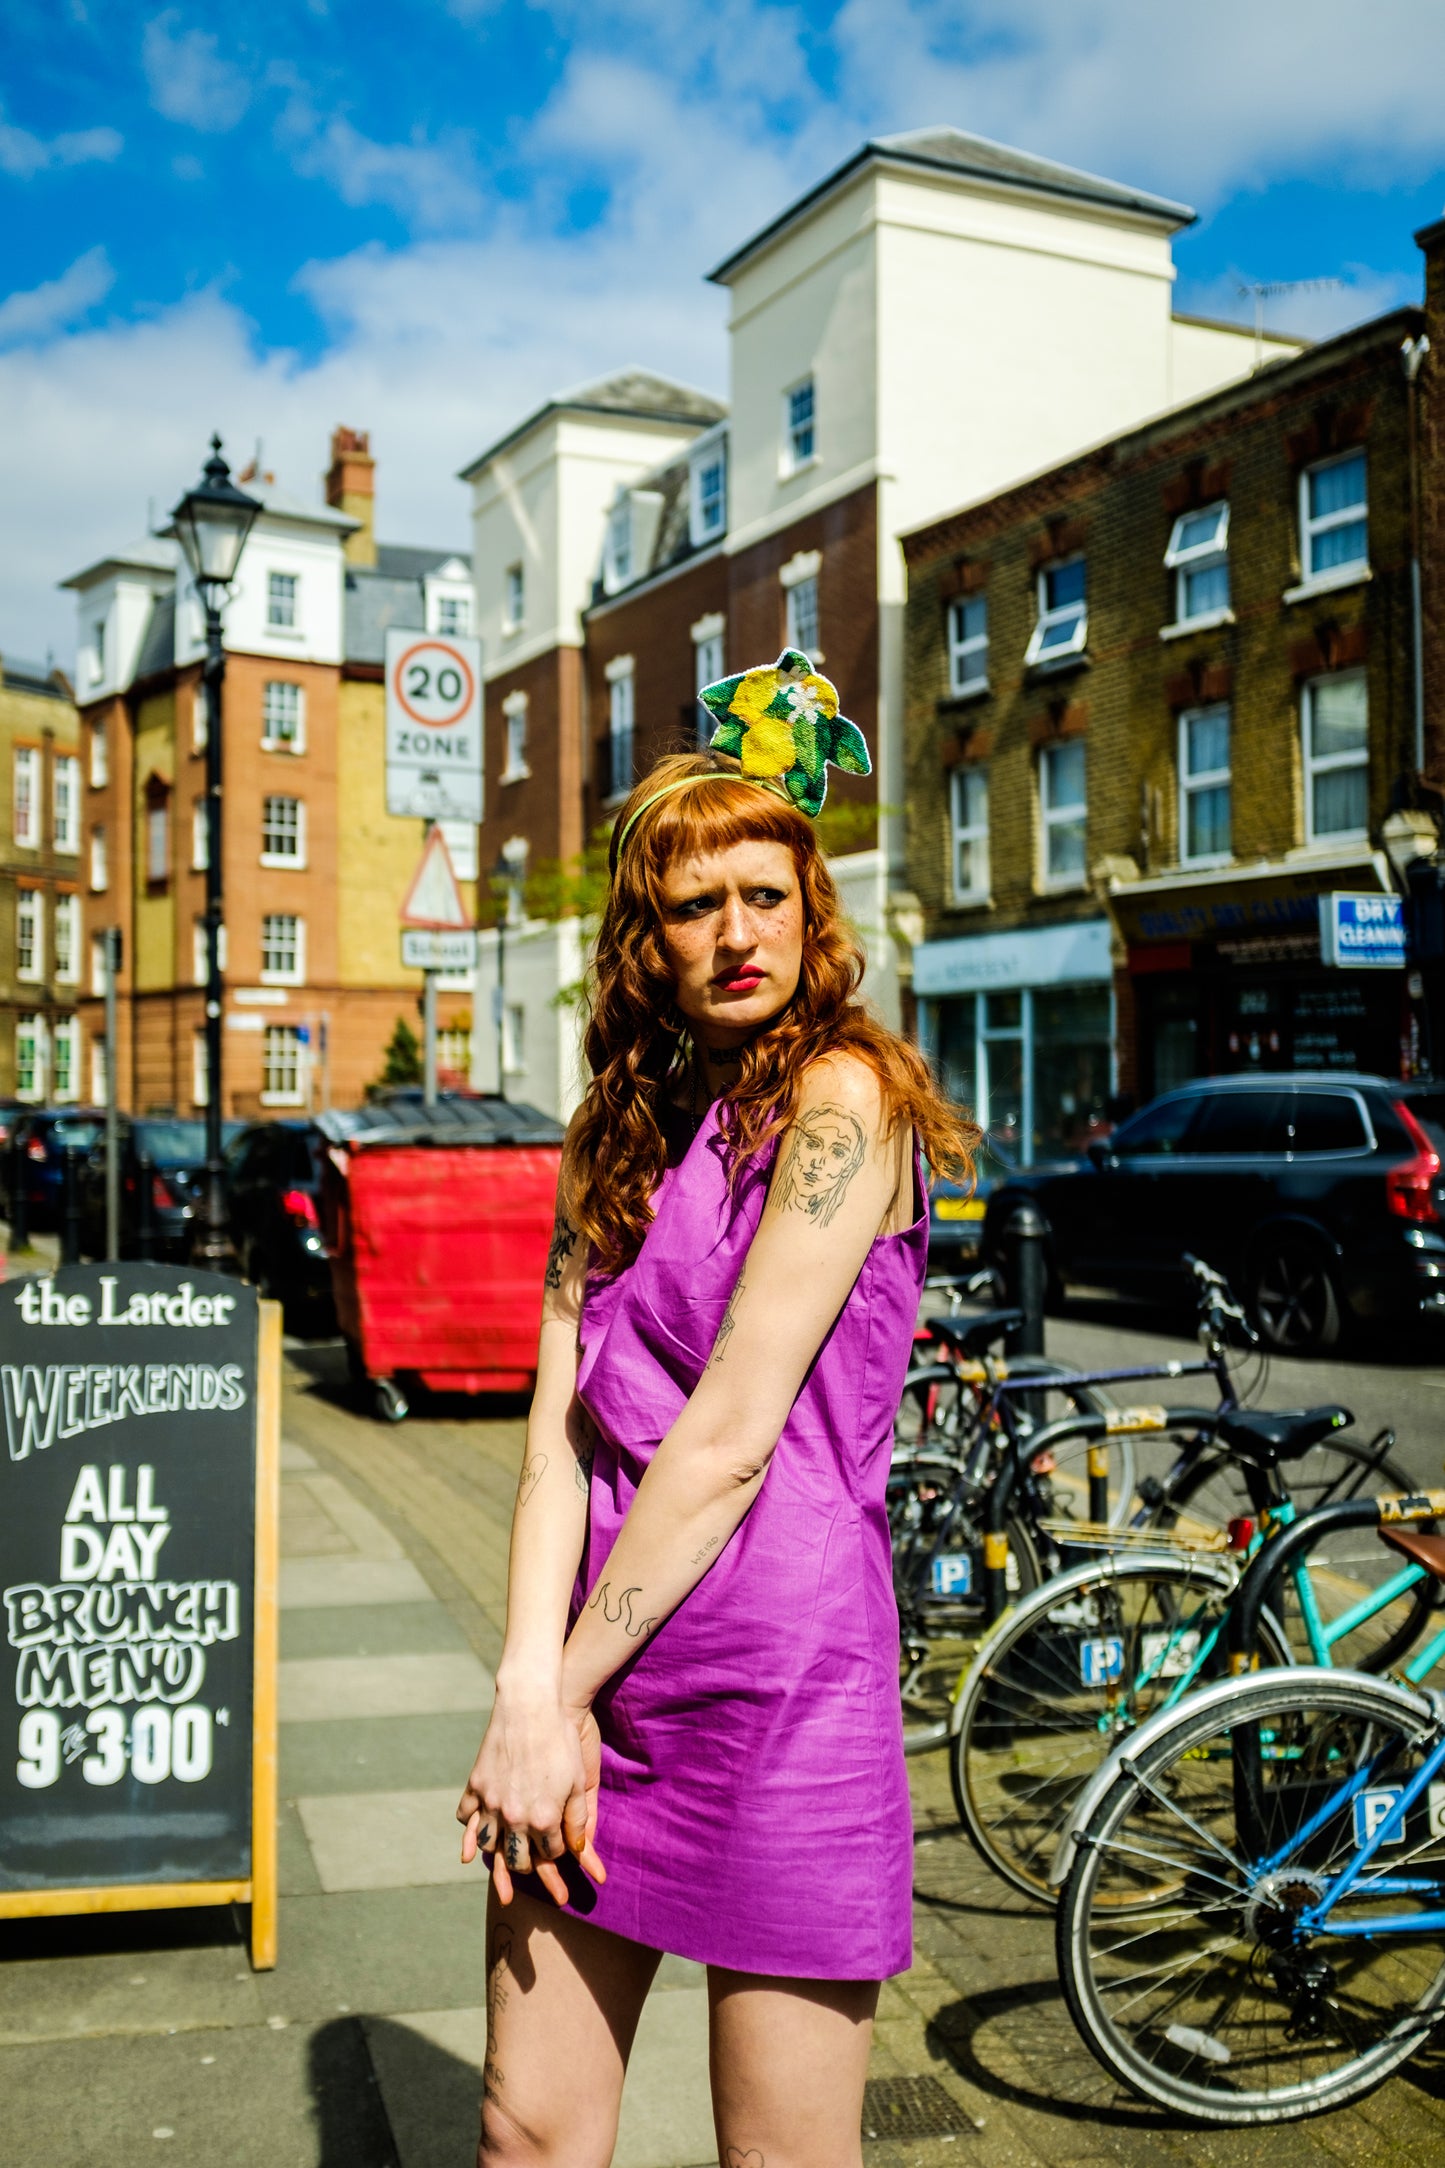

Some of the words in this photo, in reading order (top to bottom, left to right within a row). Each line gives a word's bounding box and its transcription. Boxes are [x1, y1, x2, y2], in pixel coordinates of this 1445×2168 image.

[407, 665, 462, 702] 20
[396, 730, 470, 760] ZONE
[1355, 899, 1398, 922] DRY
[14, 1278, 92, 1326] the
[97, 1276, 236, 1327] Larder
[0, 1363, 247, 1462] WEEKENDS
[65, 1464, 169, 1522] ALL
[61, 1523, 172, 1582] DAY
[690, 1536, 719, 1565] WEIRD
[4, 1581, 240, 1648] BRUNCH
[16, 1641, 205, 1707] MENU
